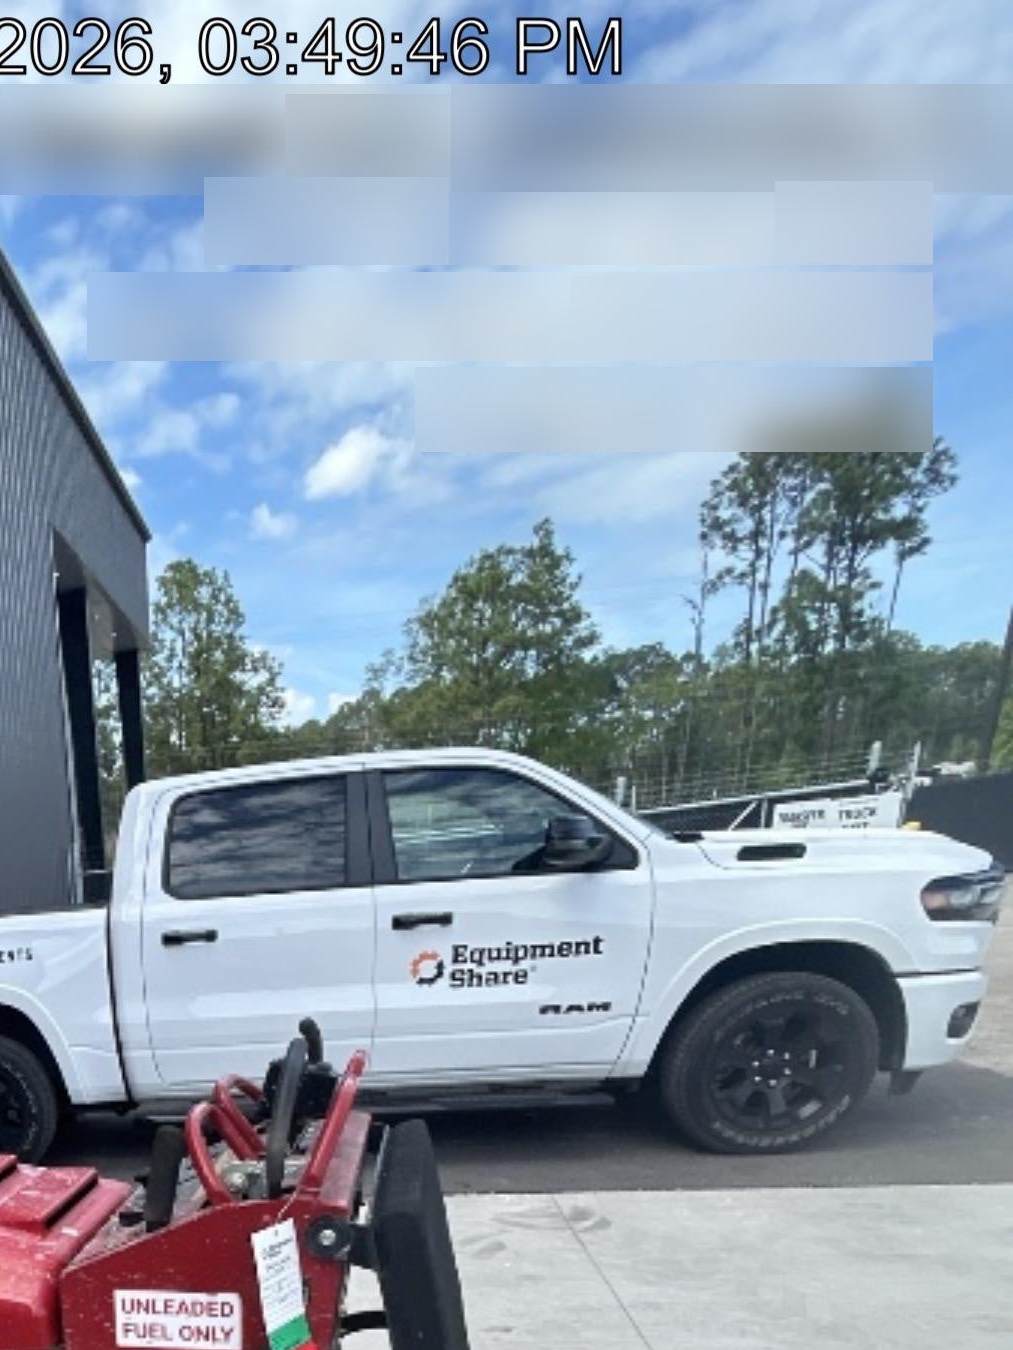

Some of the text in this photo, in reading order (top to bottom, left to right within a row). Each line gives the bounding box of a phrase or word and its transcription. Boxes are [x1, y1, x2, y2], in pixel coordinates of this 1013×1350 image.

[451, 935, 605, 967] Equipment
[449, 968, 529, 988] Share
[538, 1001, 612, 1015] RAM
[121, 1298, 234, 1318] UNLEADED
[122, 1323, 234, 1343] FUEL ONLY
